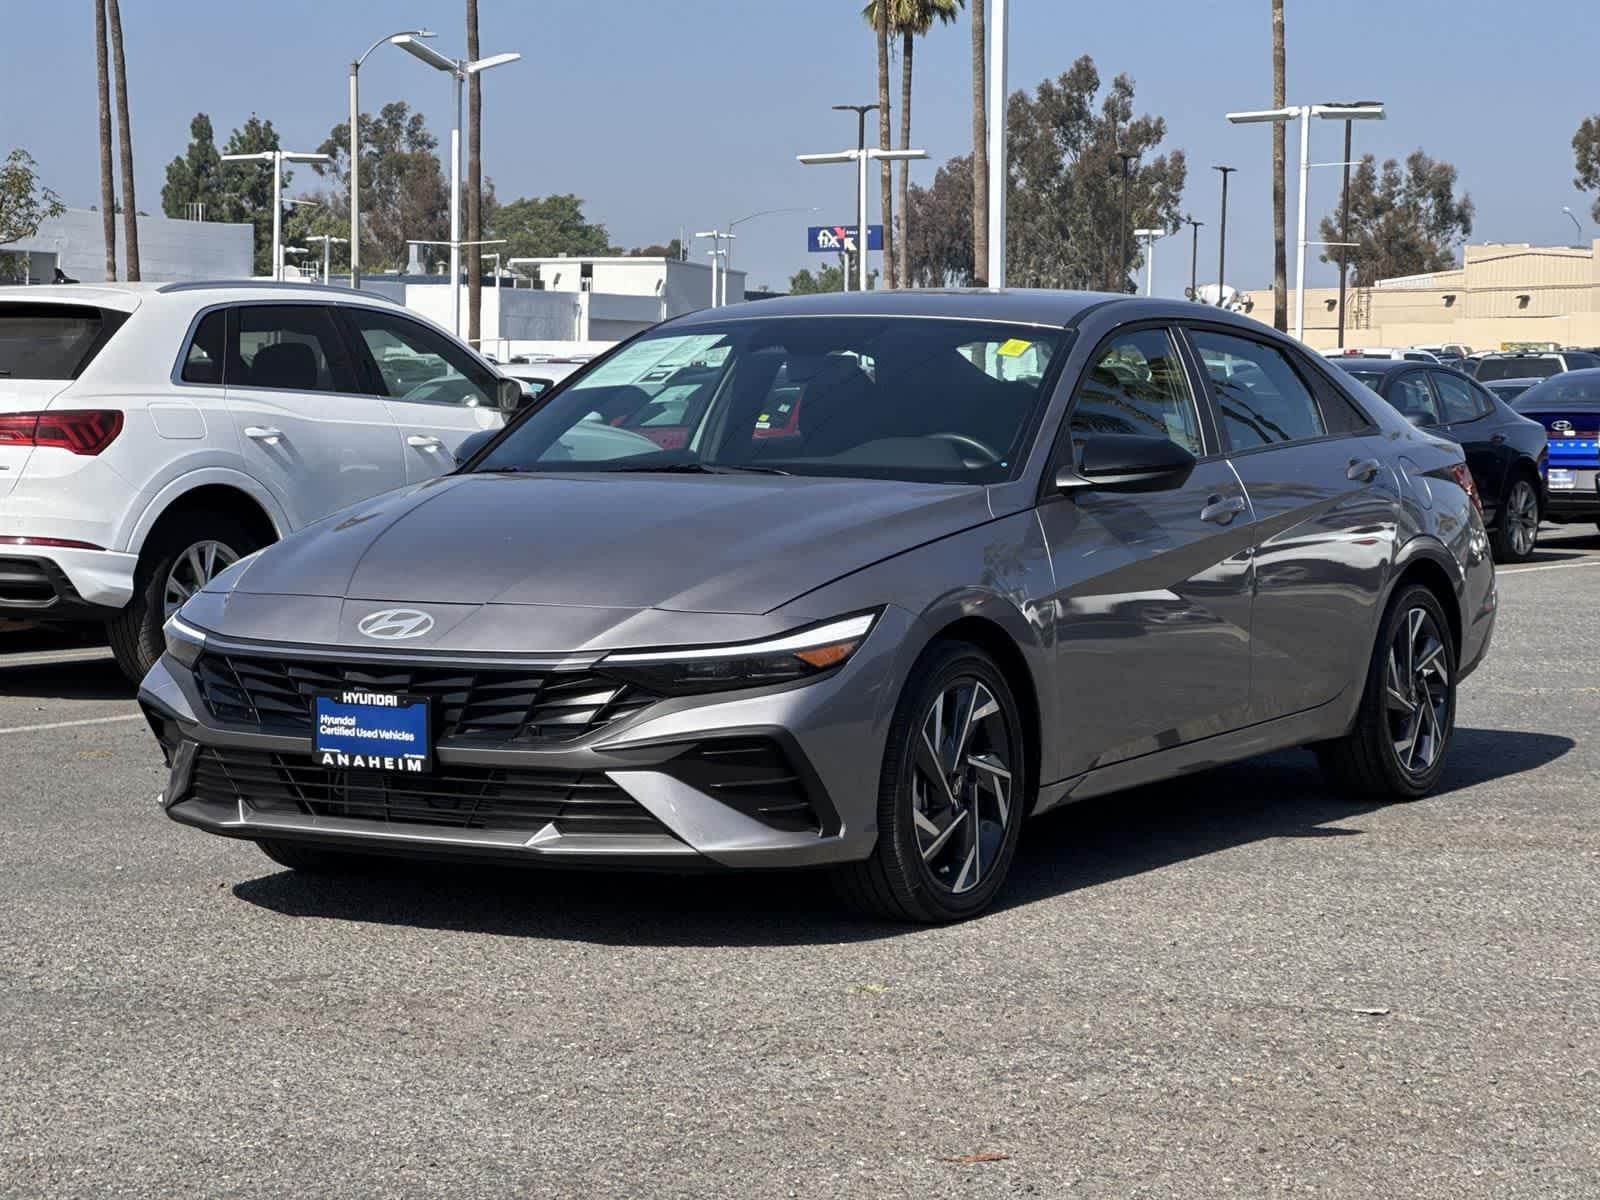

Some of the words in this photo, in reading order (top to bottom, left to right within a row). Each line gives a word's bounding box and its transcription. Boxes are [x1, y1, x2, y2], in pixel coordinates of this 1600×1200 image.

[343, 692, 398, 707] HYUNDAI
[320, 714, 356, 726] Hyundai
[319, 725, 355, 737] Certified
[356, 727, 378, 739] Used
[378, 729, 415, 741] Vehicles
[322, 753, 422, 772] ANAHEIM
